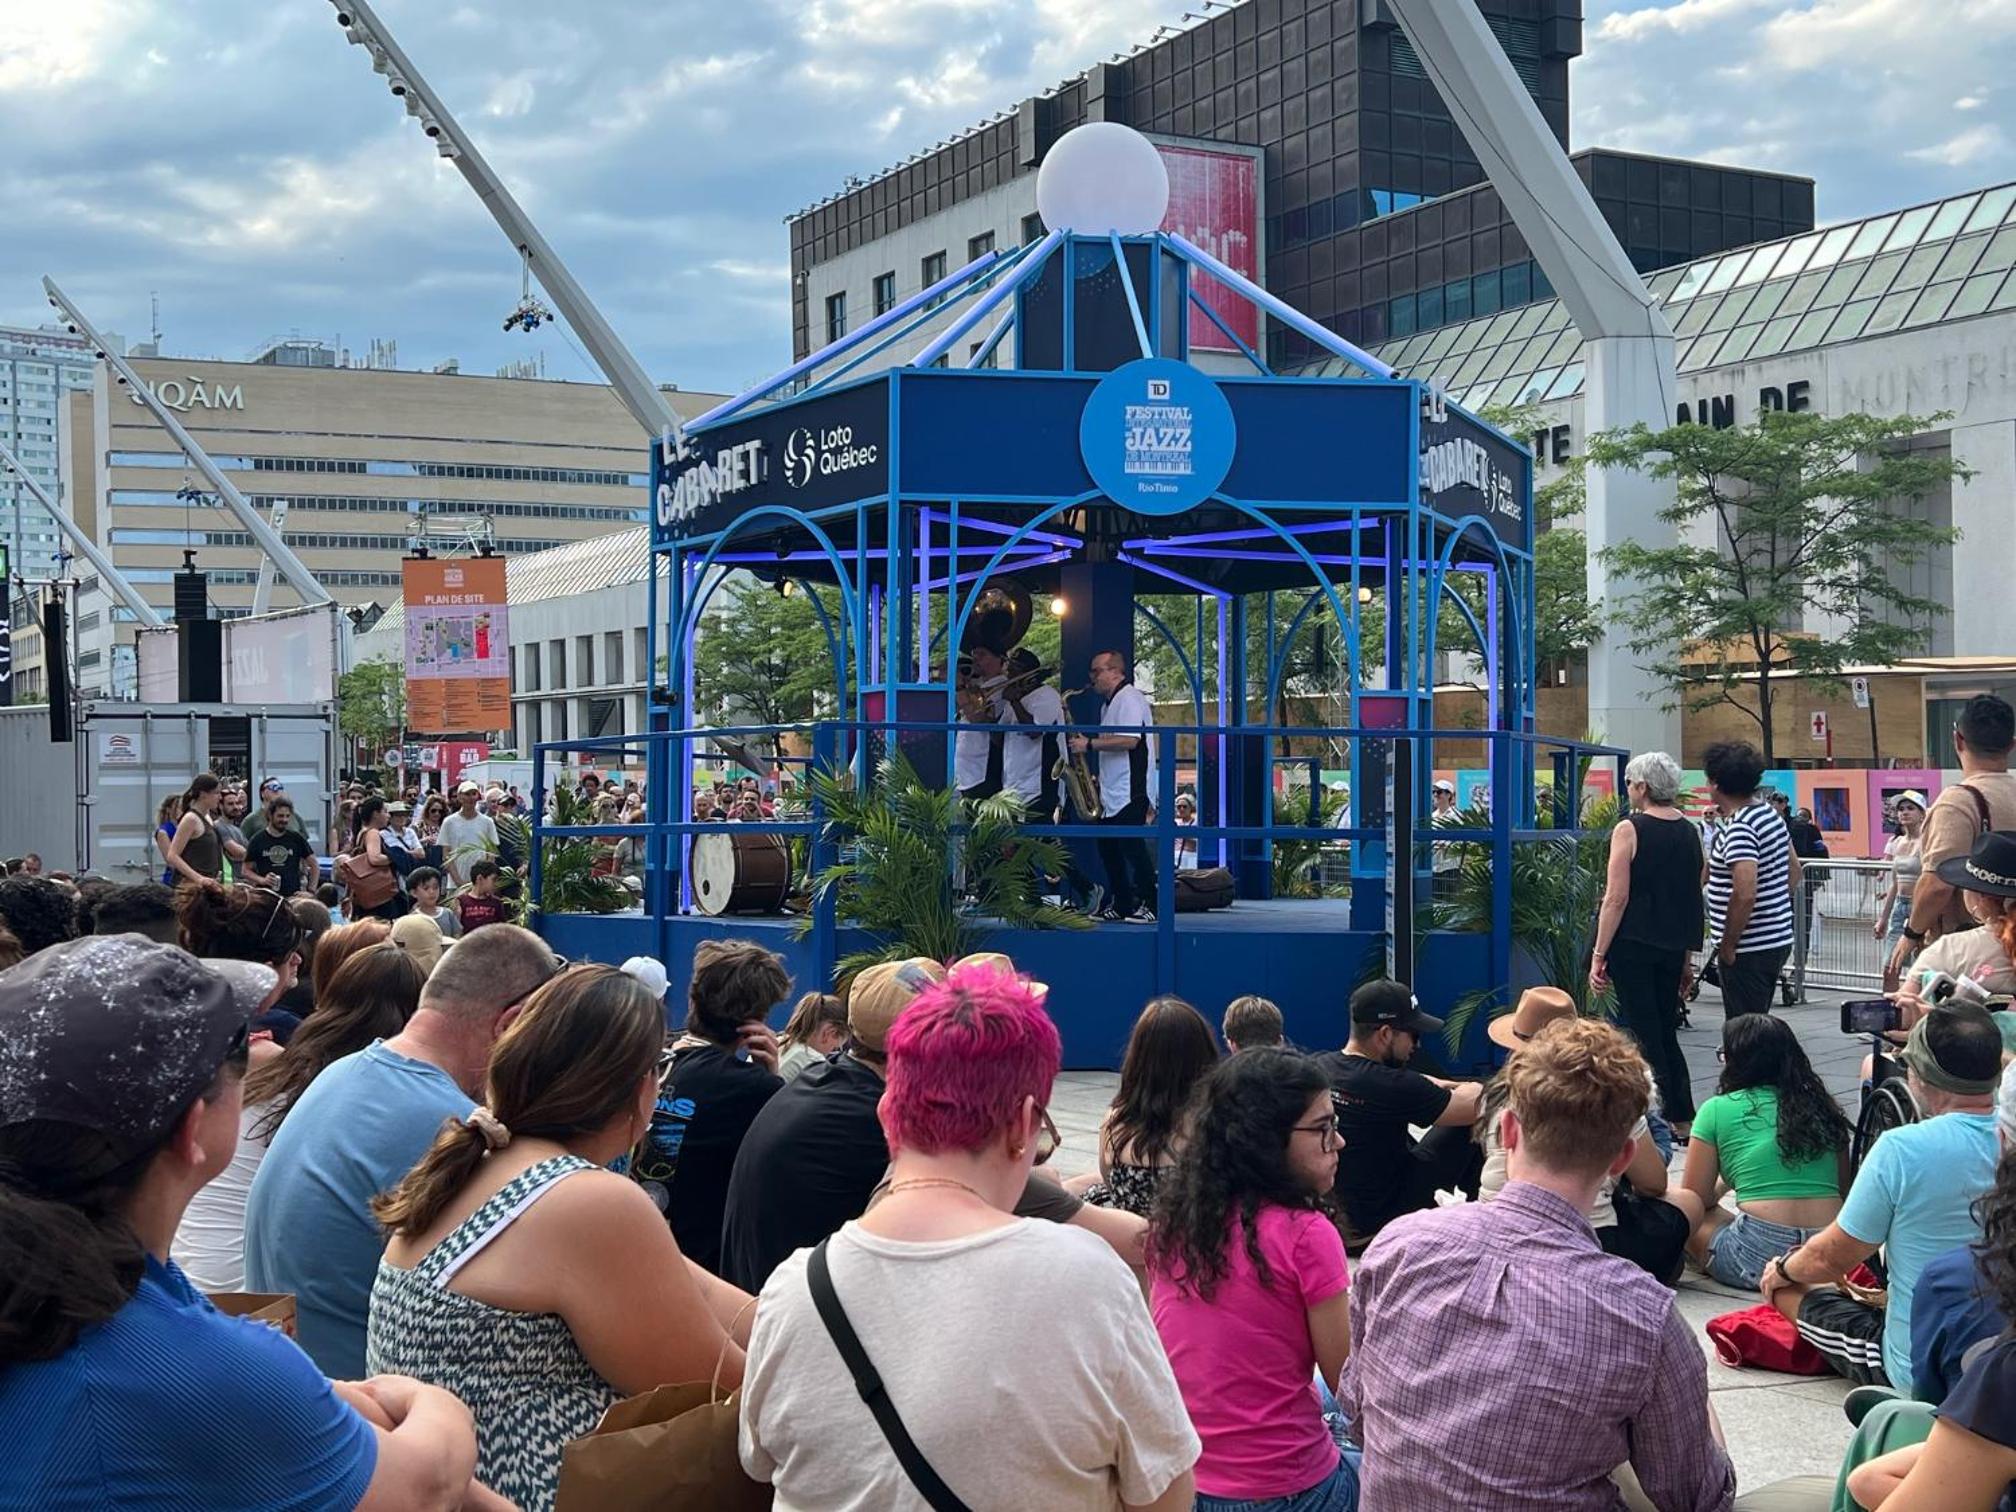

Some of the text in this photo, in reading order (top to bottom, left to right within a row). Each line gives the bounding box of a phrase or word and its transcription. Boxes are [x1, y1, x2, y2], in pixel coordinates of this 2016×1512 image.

[1151, 383, 1168, 396] TD
[1125, 406, 1192, 420] FESTIVAL
[821, 426, 852, 450] Loto
[1125, 427, 1192, 452] JAZZ
[820, 445, 877, 475] Québec
[1428, 437, 1487, 494] CABARET
[657, 440, 762, 526] CABARET
[425, 594, 484, 605] PLAN DE SITE
